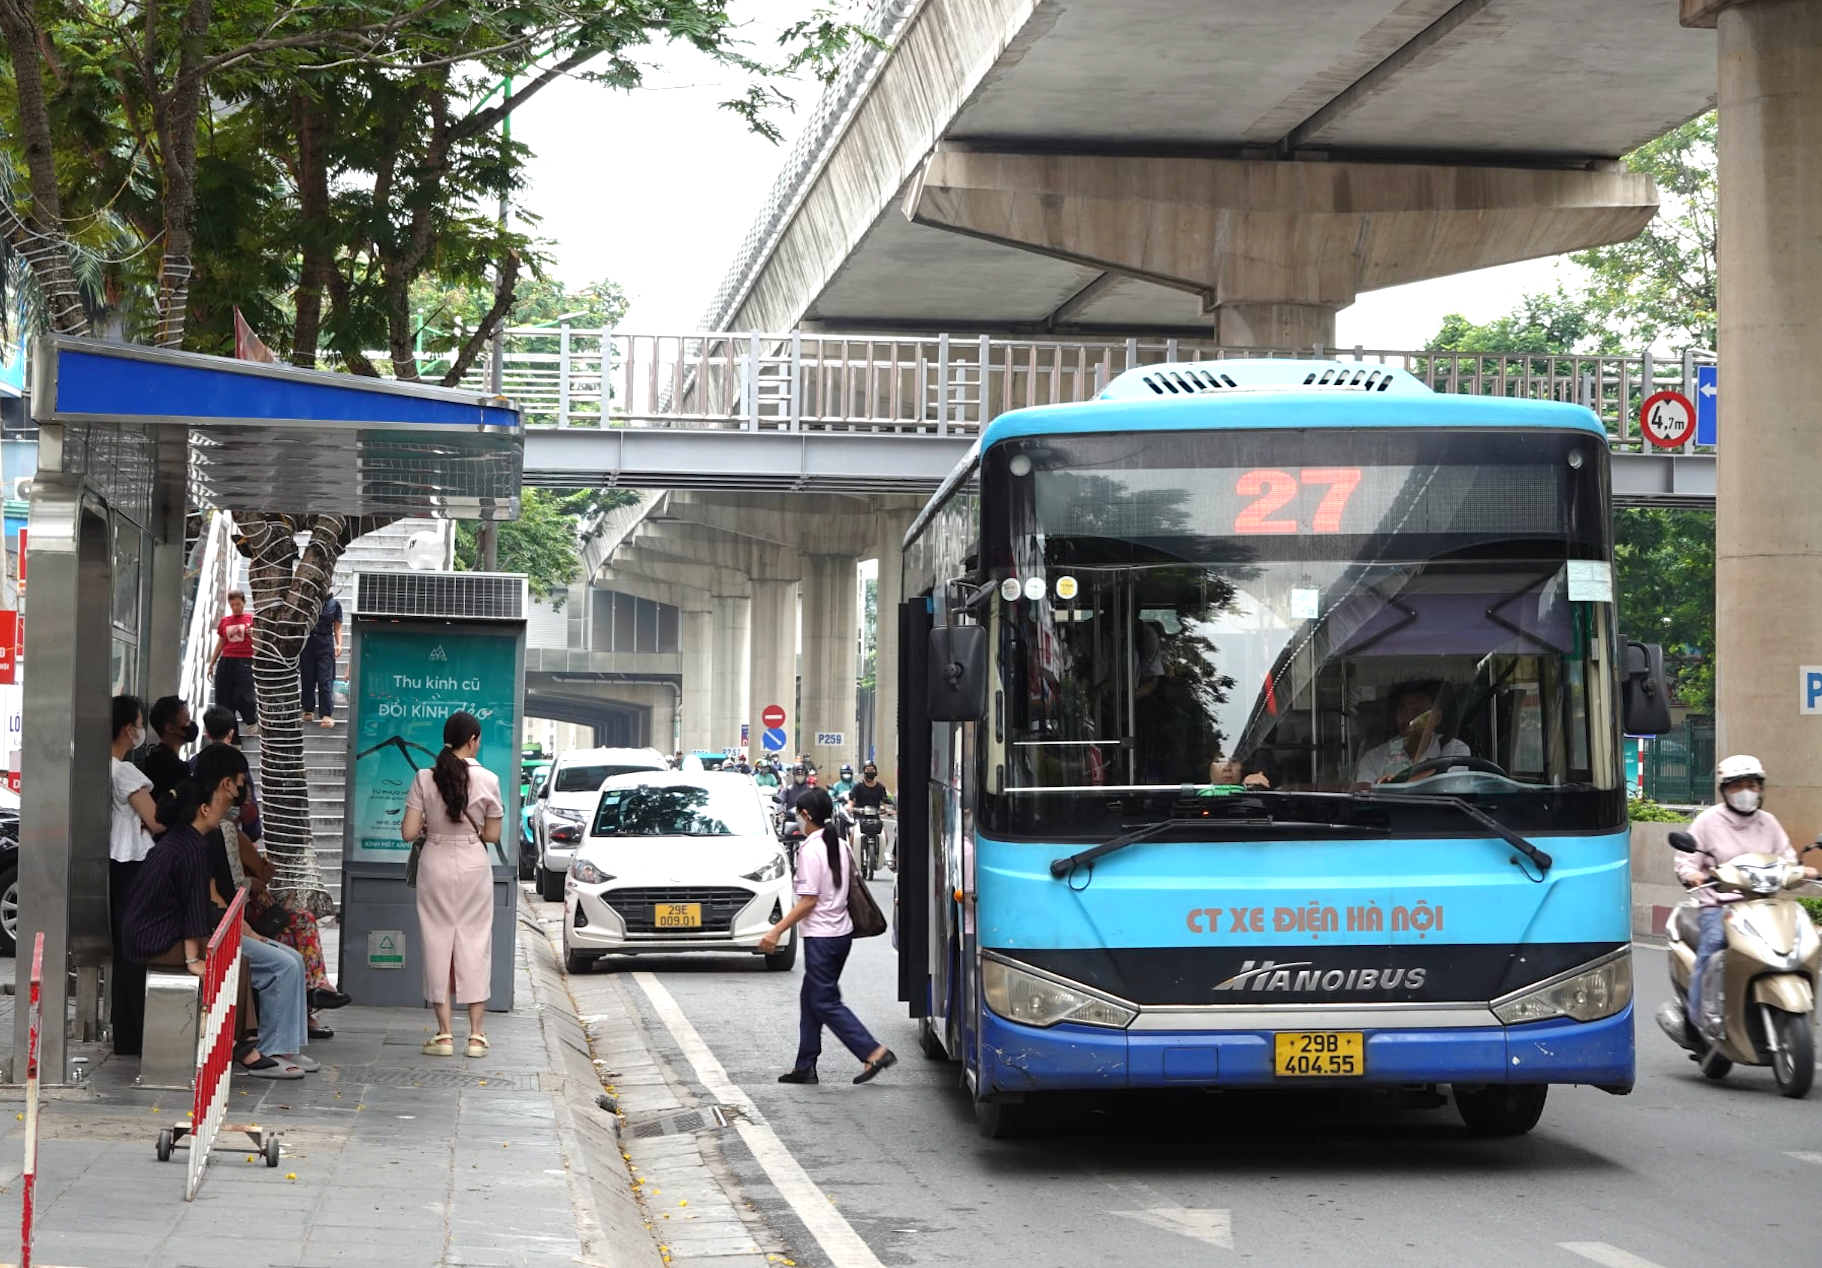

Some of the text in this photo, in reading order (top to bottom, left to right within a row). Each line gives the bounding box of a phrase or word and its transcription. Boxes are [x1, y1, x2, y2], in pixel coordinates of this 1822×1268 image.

[1651, 405, 1685, 431] 4,7m
[1234, 469, 1361, 533] 27
[393, 674, 480, 691] Thu kính cũ
[378, 697, 407, 717] ĐỔI
[411, 698, 449, 718] KÍNH
[9, 709, 23, 732] LỐ
[818, 733, 842, 745] P259
[668, 905, 688, 915] 29E
[1186, 899, 1444, 940] CT XE ĐIỆN HÀ NỘI
[660, 916, 695, 926] 009.01
[1212, 960, 1427, 992] HANOIBUS
[1301, 1034, 1338, 1053] 29B
[1285, 1055, 1355, 1074] 404.55
